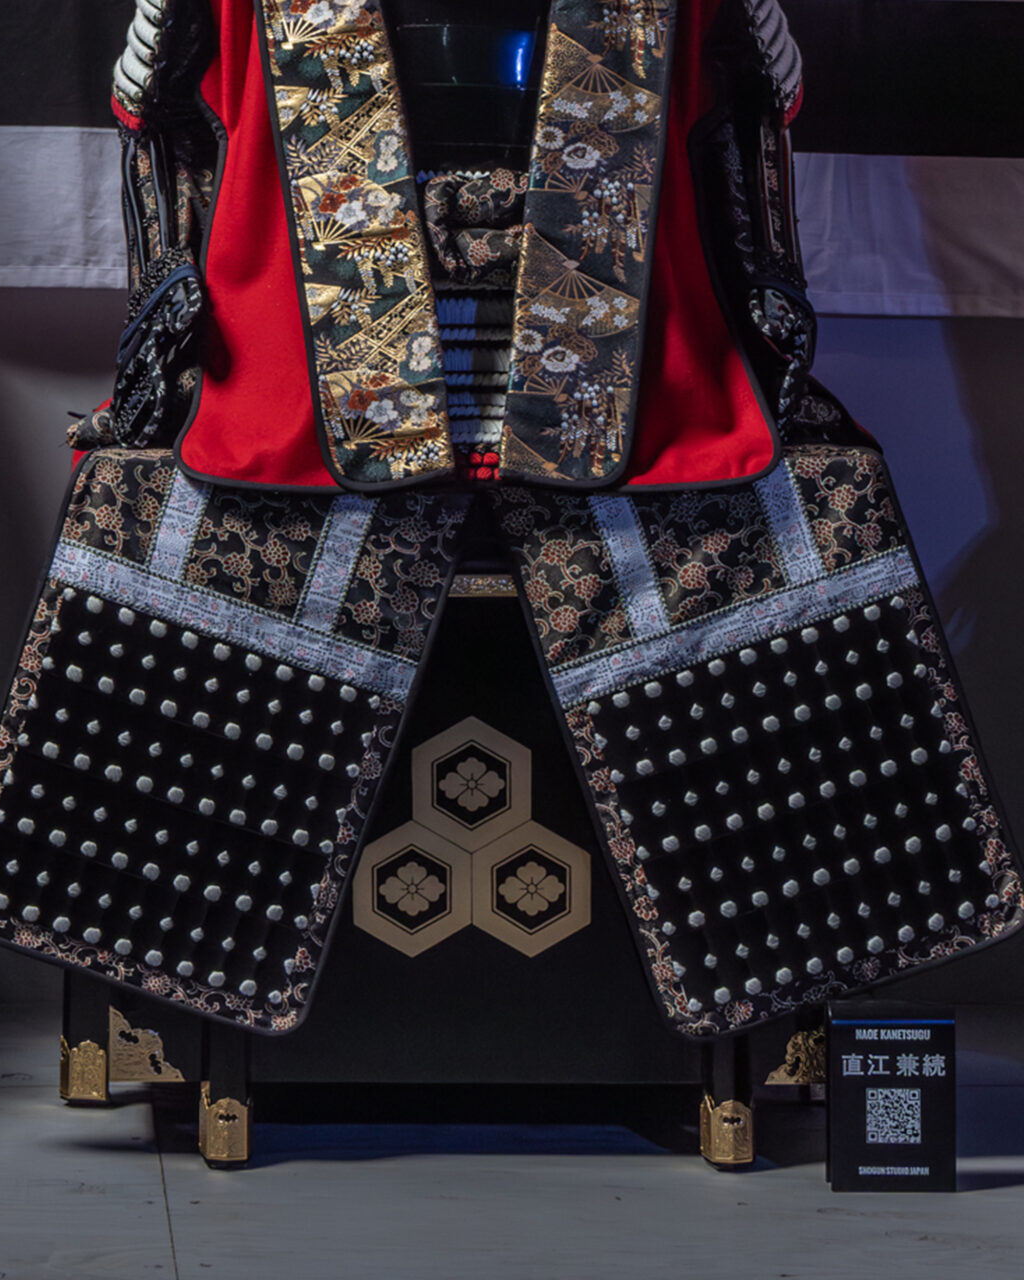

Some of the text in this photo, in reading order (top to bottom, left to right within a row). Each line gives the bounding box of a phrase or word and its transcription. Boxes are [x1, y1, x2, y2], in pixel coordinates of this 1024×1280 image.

[855, 1028, 931, 1041] NAOE KANETSUGU
[841, 1052, 946, 1077] 直江 兼続
